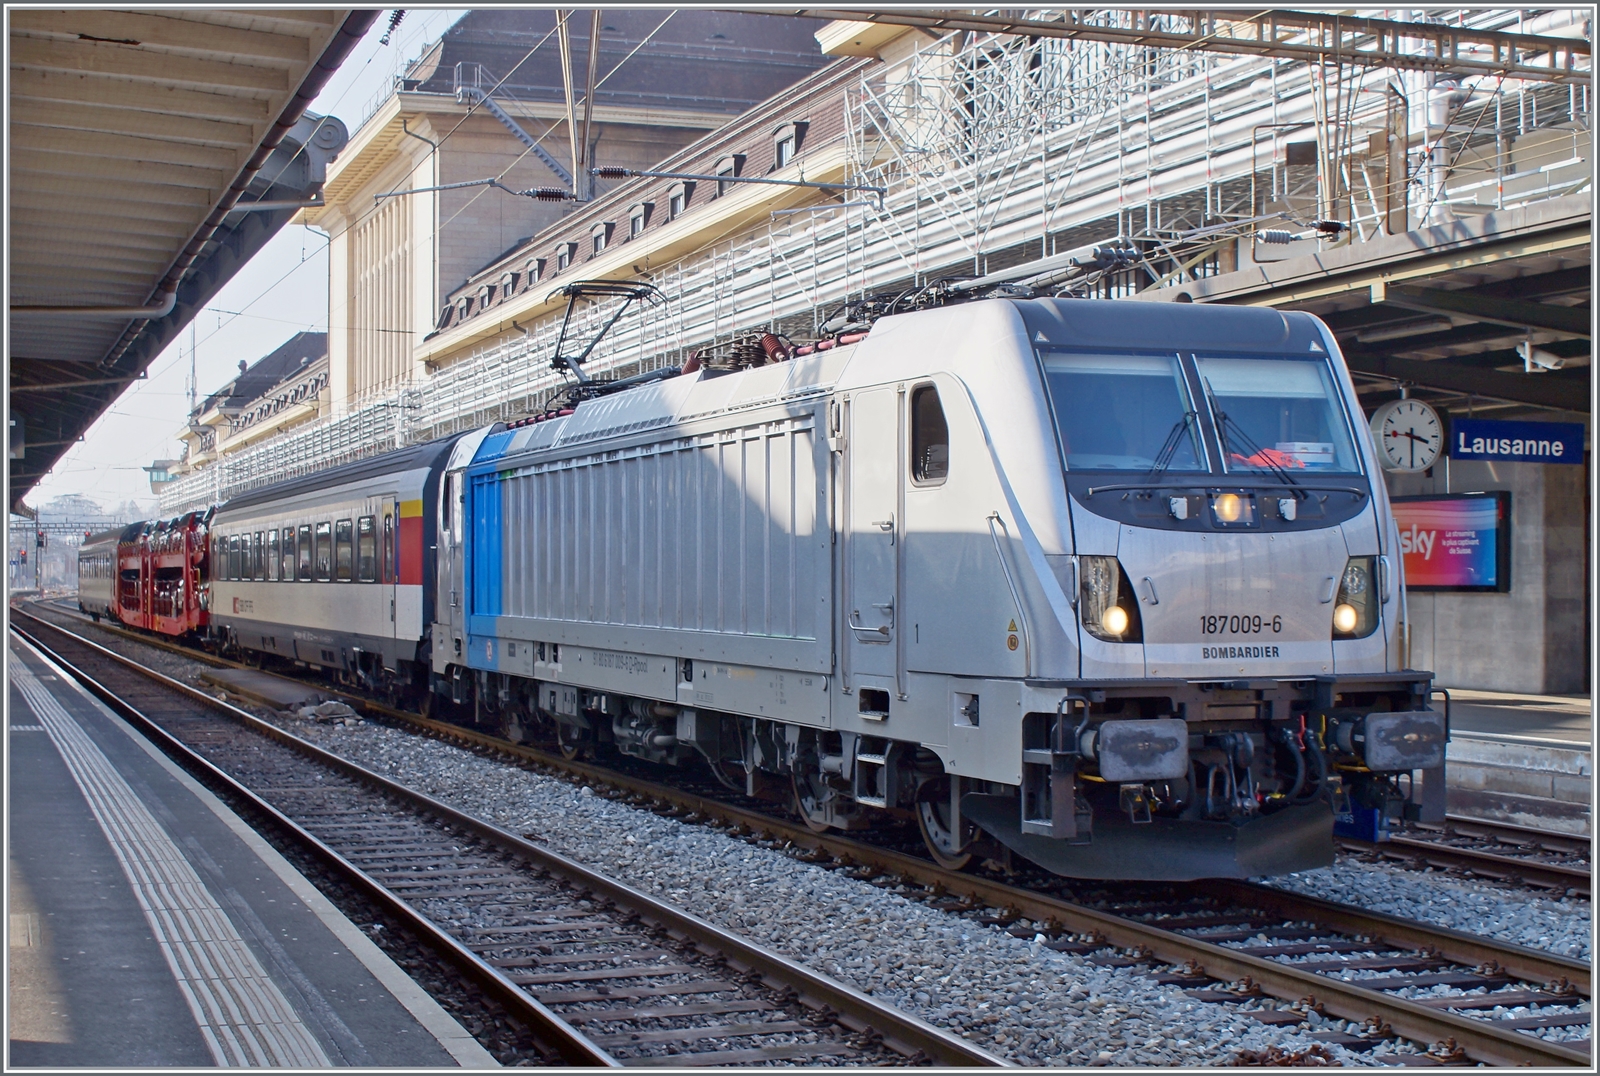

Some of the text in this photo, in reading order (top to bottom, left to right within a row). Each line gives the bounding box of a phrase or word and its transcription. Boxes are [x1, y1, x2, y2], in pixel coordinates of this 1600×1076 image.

[1459, 432, 1564, 456] Lausanne
[1452, 530, 1476, 538] streaming
[1400, 523, 1436, 560] sky
[1447, 539, 1457, 547] plus
[1457, 538, 1480, 546] captivant
[1202, 646, 1280, 659] BOMBARDIER
